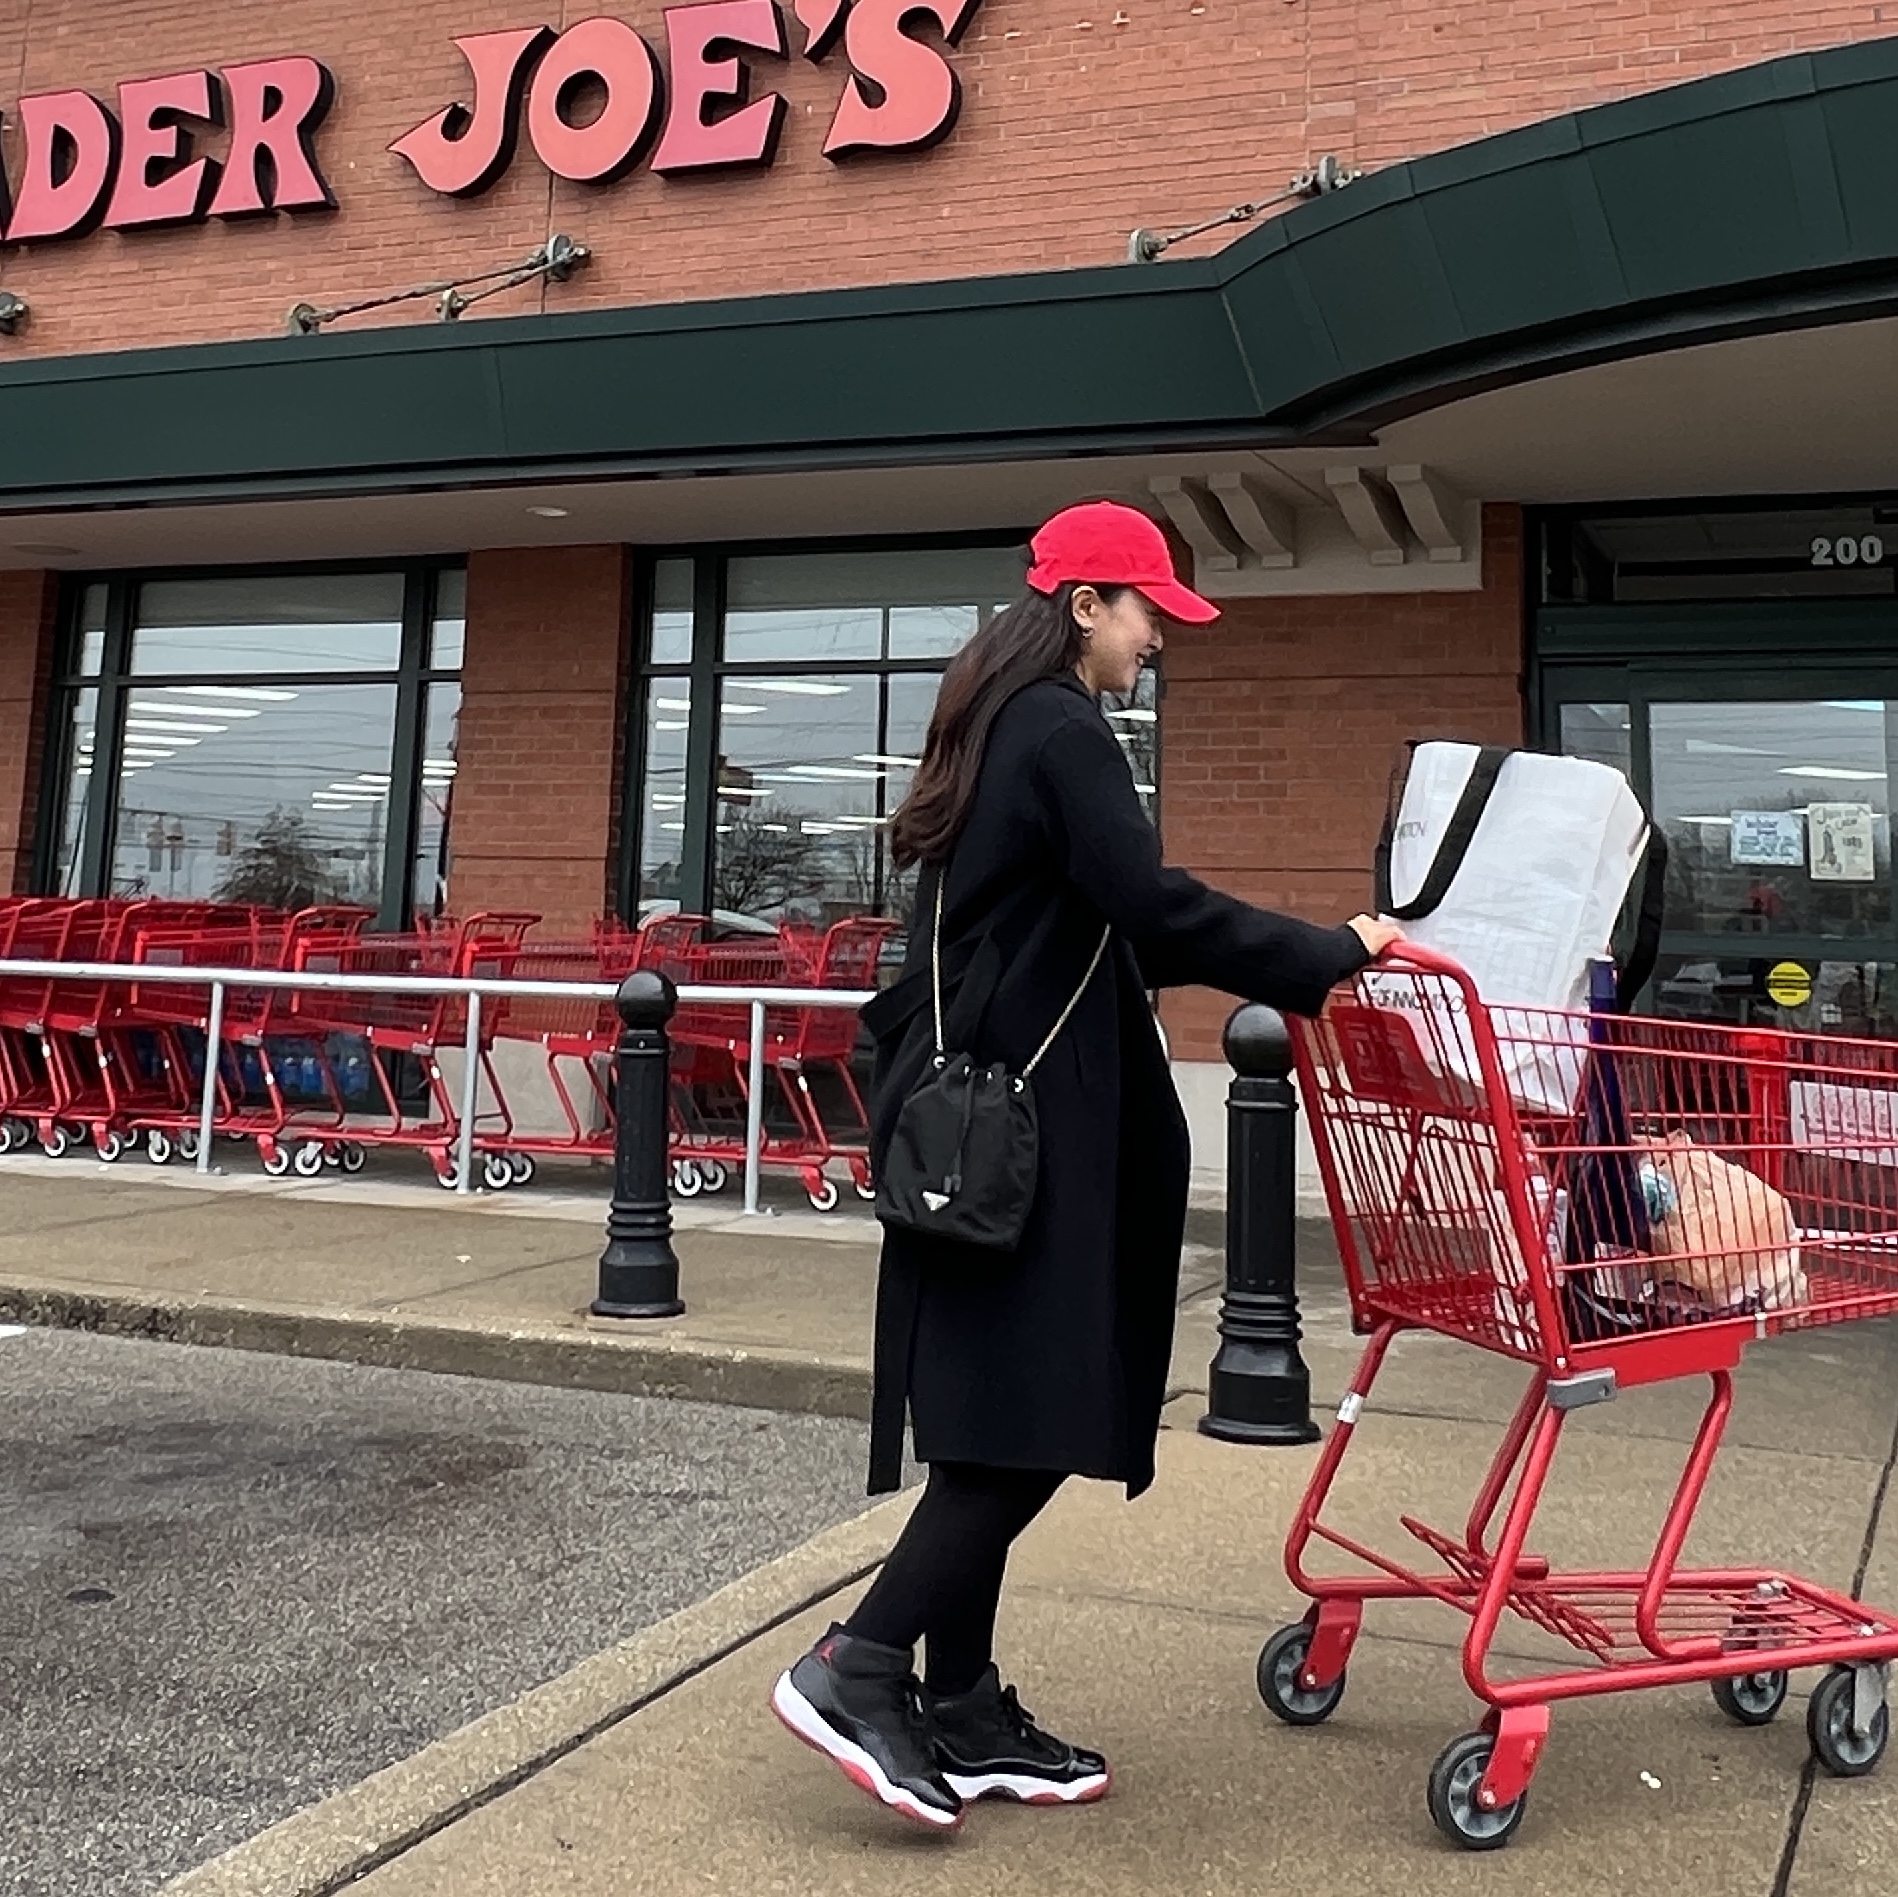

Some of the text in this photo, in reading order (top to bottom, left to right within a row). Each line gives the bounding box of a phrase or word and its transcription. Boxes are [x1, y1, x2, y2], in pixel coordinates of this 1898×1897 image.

[0, 0, 980, 244] DER JOE'S
[1810, 535, 1883, 566] 200
